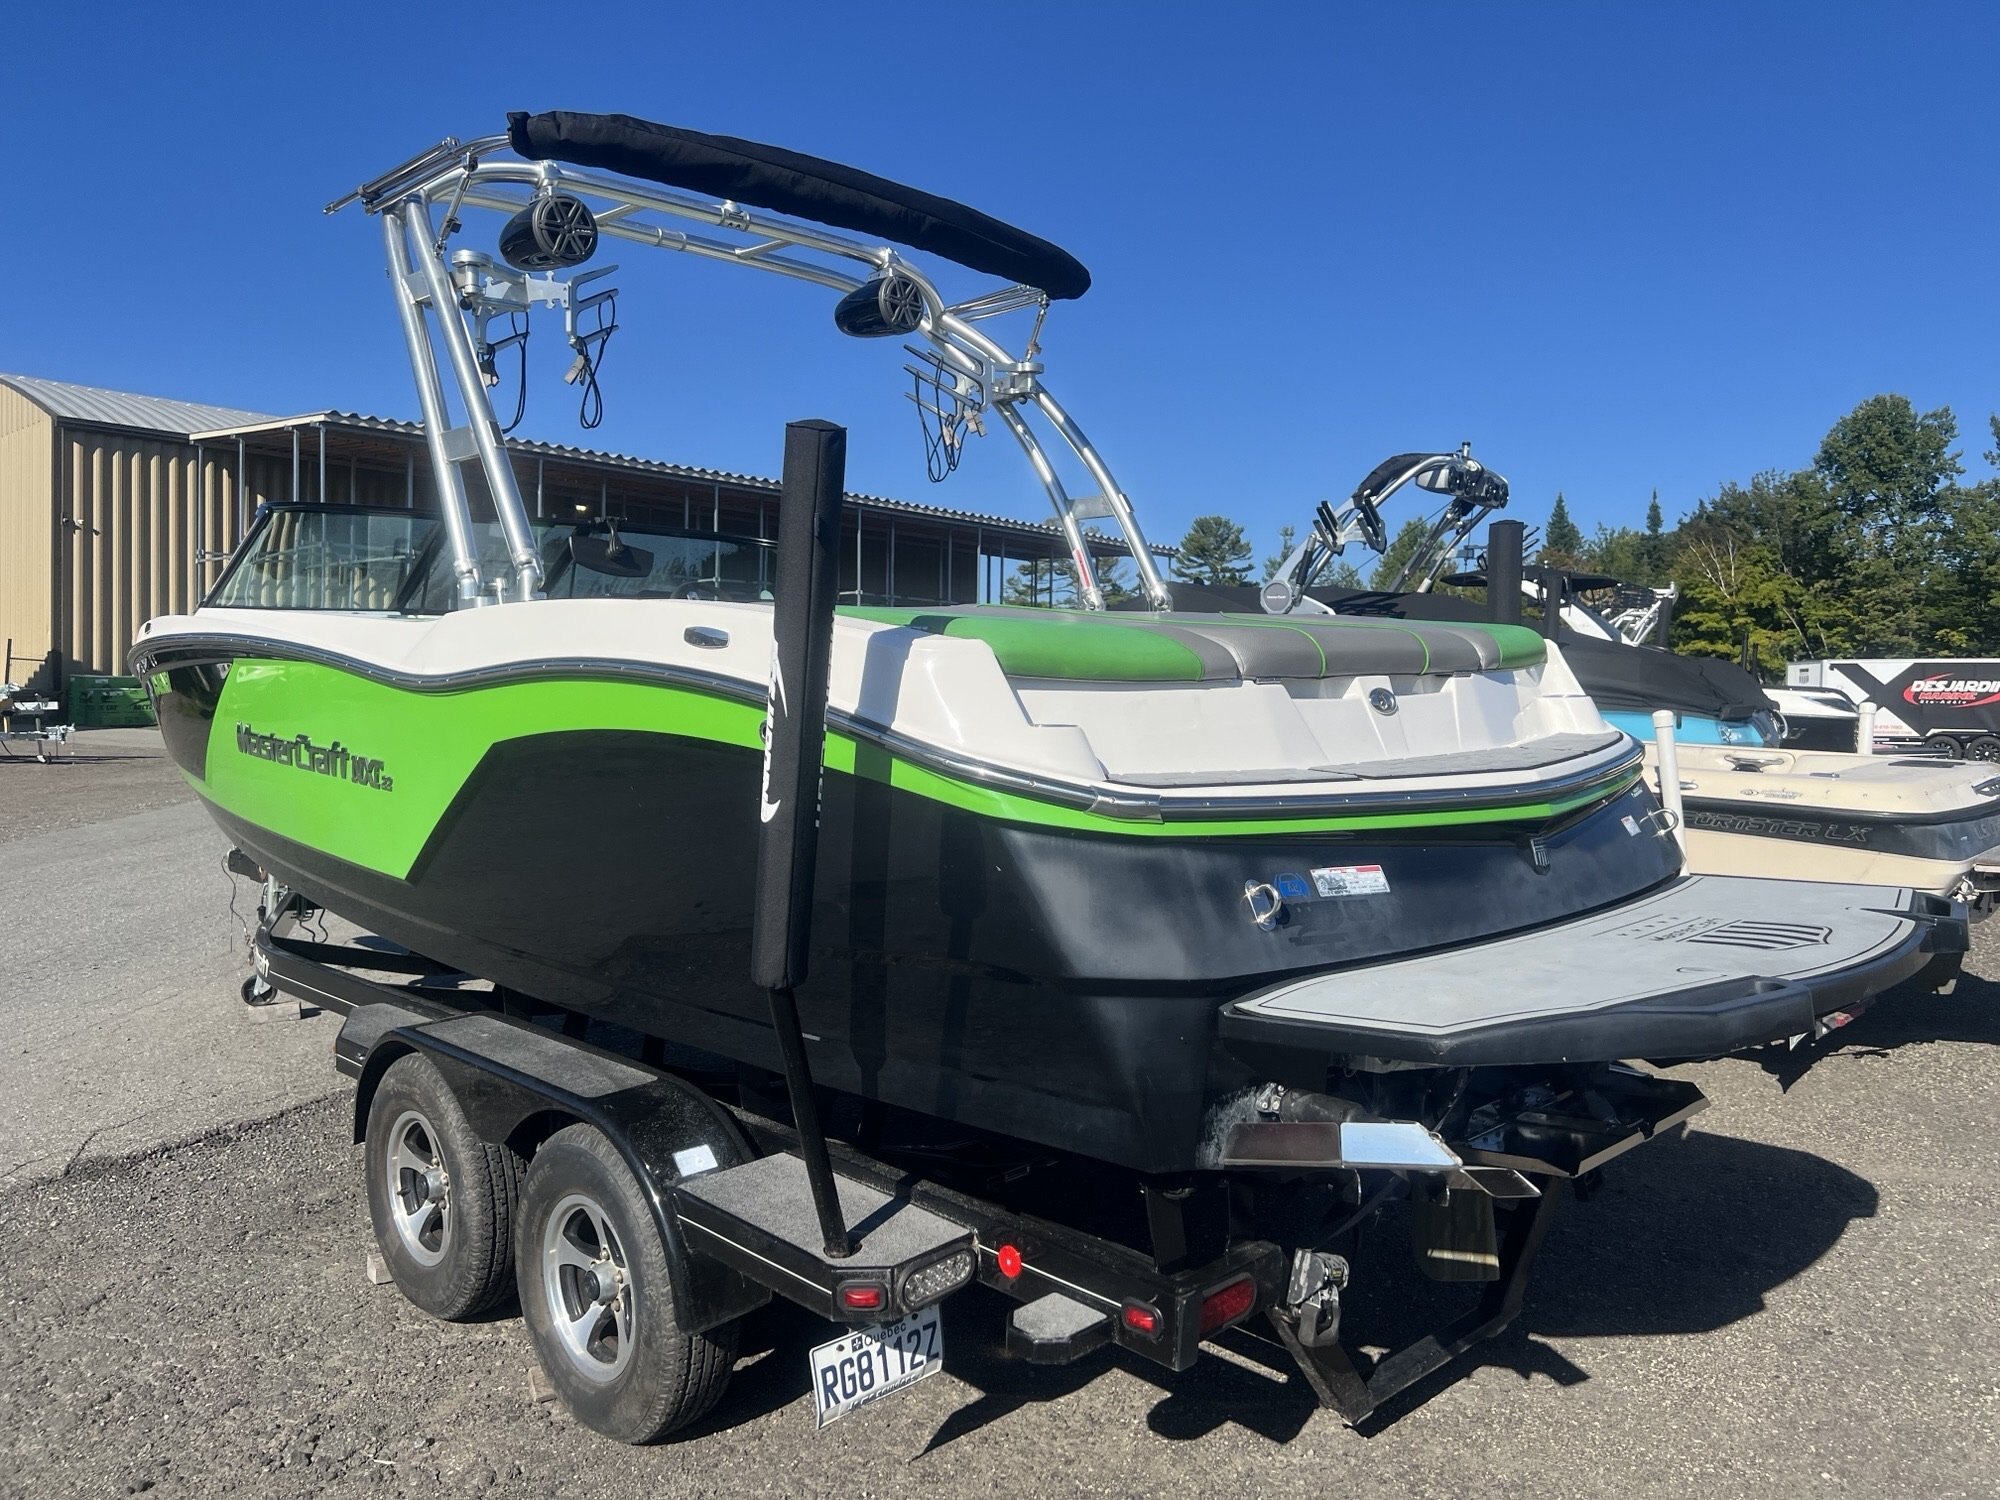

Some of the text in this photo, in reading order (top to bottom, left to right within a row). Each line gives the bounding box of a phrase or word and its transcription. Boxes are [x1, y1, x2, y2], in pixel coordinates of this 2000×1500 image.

[1918, 692, 1977, 701] MARINE
[236, 720, 350, 780] MasterCraft
[1824, 824, 1874, 842] LX
[820, 1320, 940, 1409] RG8112Z
